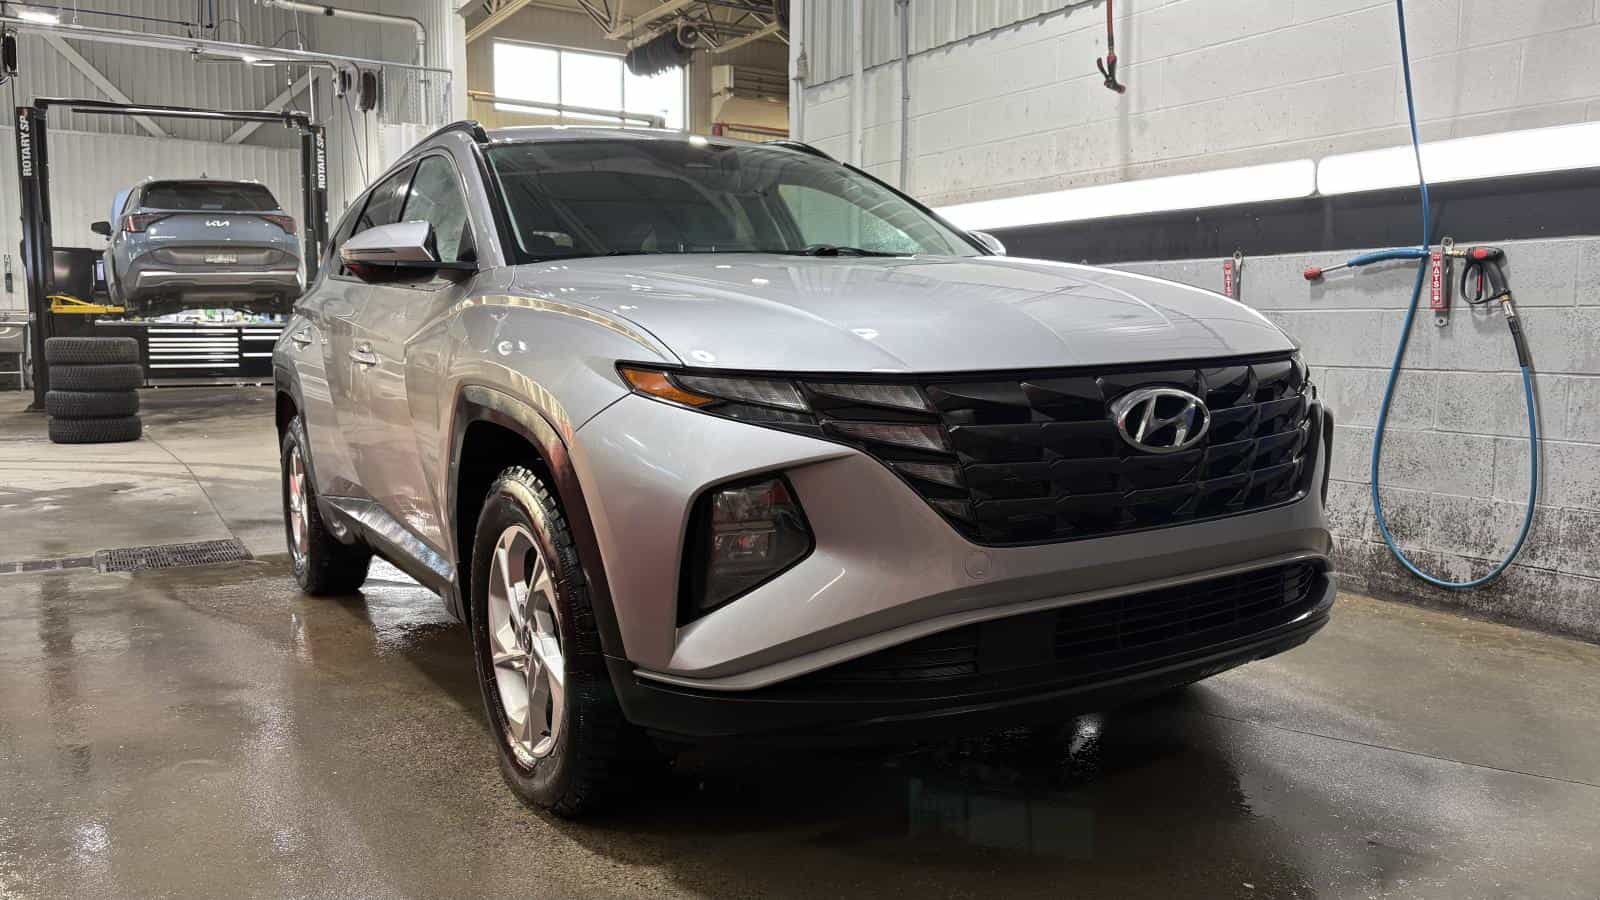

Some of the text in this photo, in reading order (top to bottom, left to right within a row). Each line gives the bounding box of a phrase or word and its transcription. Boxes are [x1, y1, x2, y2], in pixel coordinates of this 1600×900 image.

[20, 132, 32, 177] ROTARY
[317, 149, 326, 189] ROTARY
[1432, 261, 1441, 288] MATS
